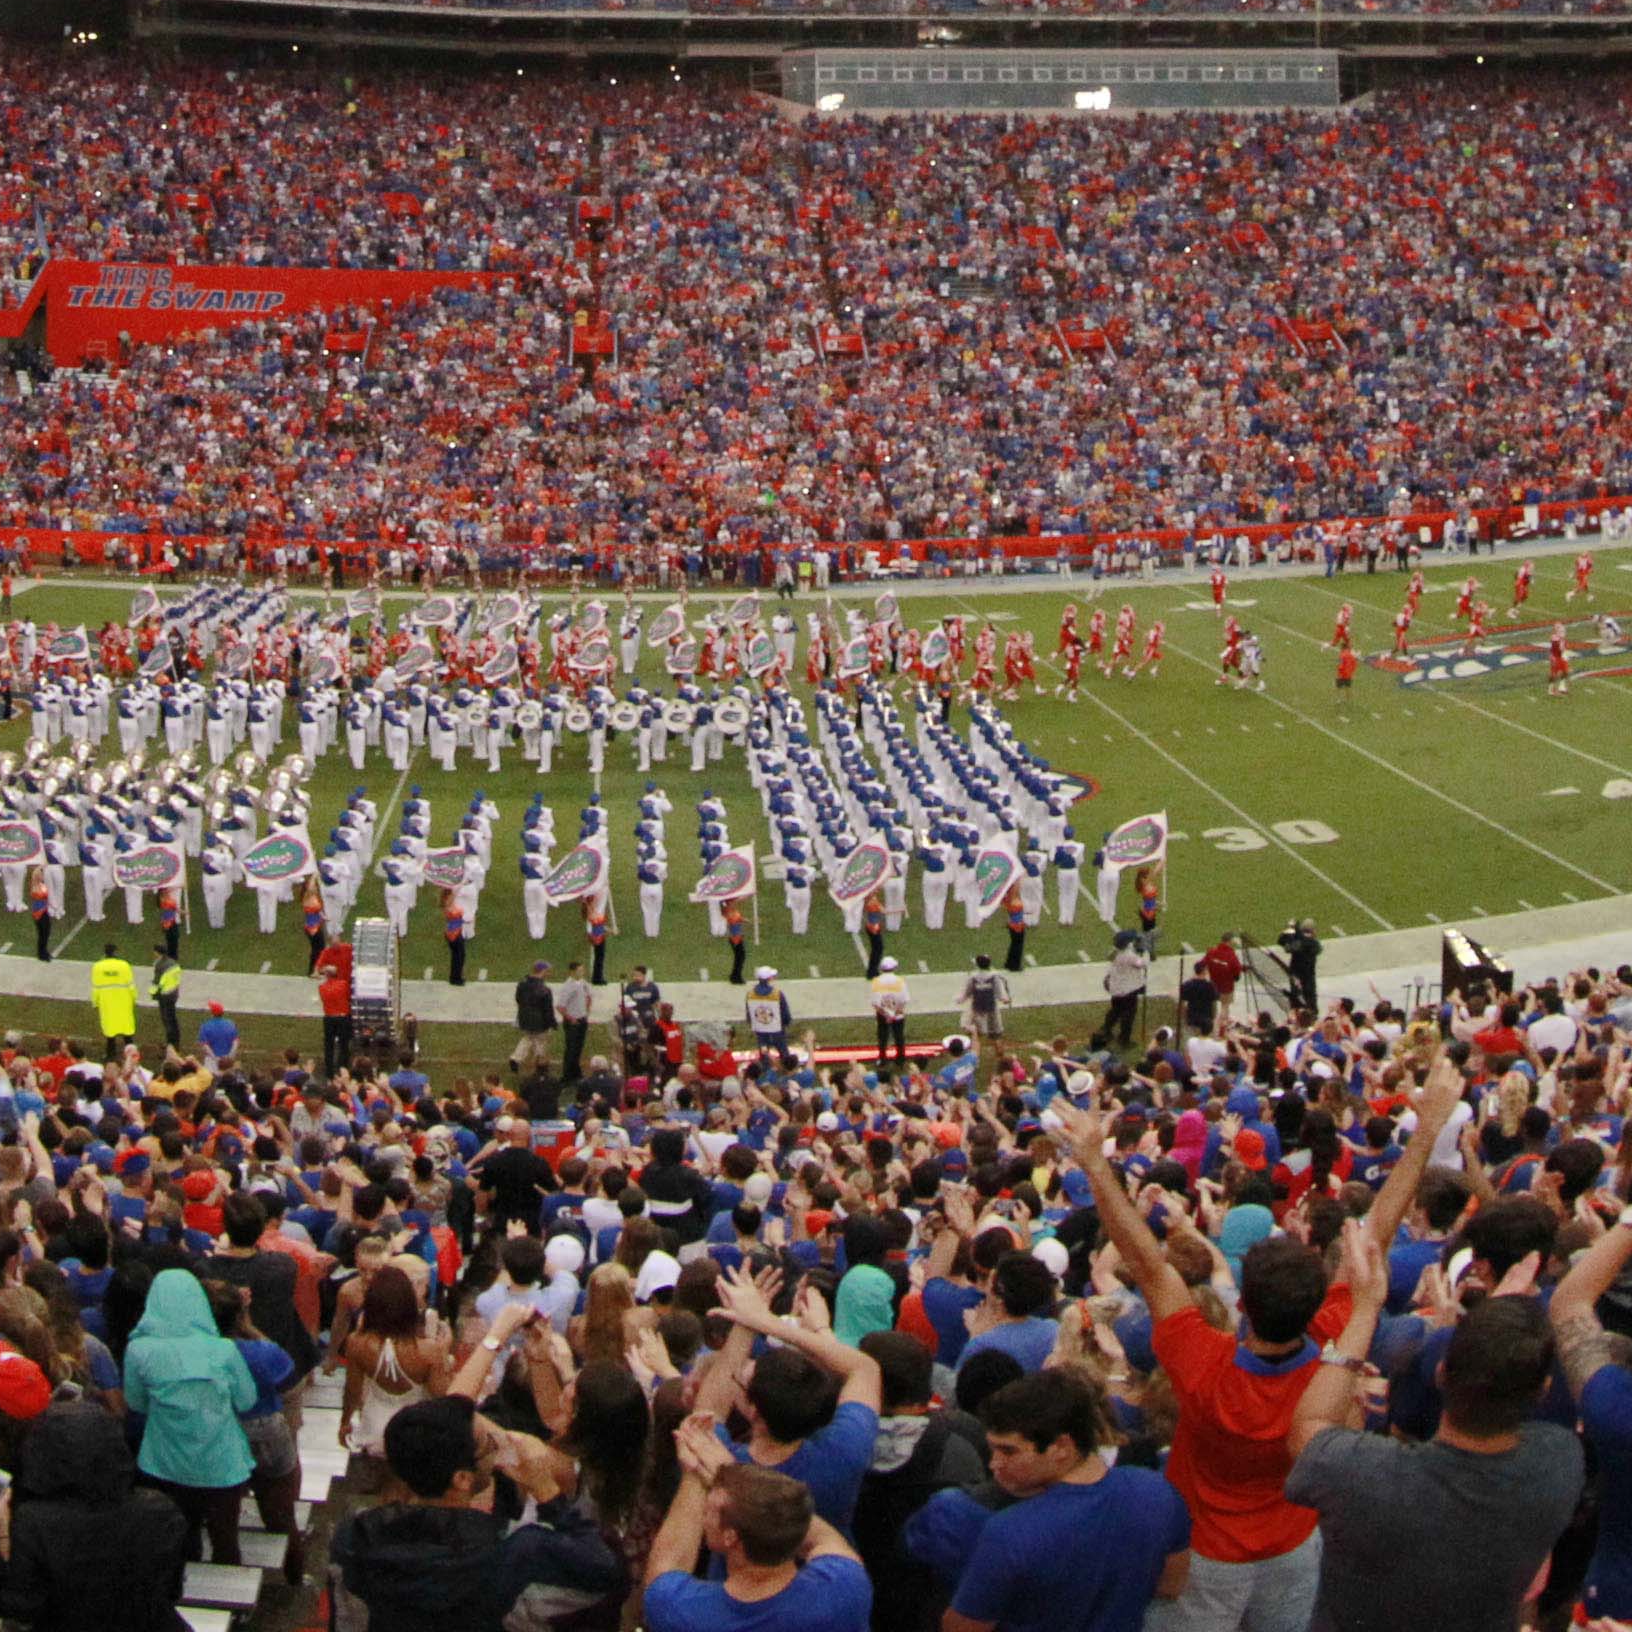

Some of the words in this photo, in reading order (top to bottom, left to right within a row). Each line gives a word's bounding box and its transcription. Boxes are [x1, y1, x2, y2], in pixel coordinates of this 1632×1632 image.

[99, 266, 150, 287] THIS
[151, 267, 173, 288] IS
[68, 285, 145, 309] THE
[148, 288, 286, 312] SWAMP
[1202, 819, 1341, 852] 30
